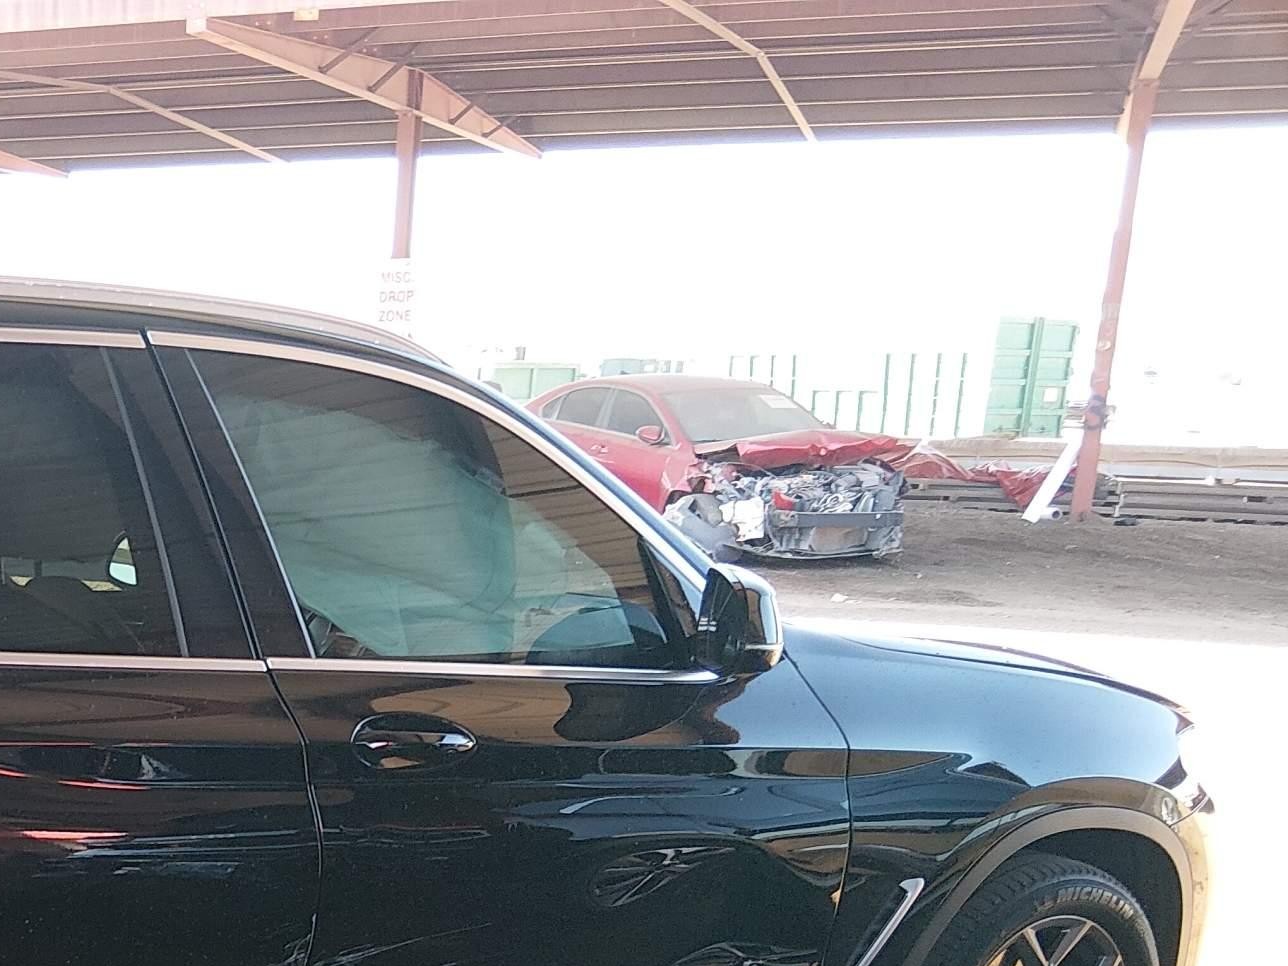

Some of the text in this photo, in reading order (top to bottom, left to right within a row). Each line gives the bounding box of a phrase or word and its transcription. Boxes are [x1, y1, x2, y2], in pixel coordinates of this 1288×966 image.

[379, 290, 414, 303] DROP
[378, 310, 411, 322] ZONE
[1058, 887, 1134, 919] MICHELIN
